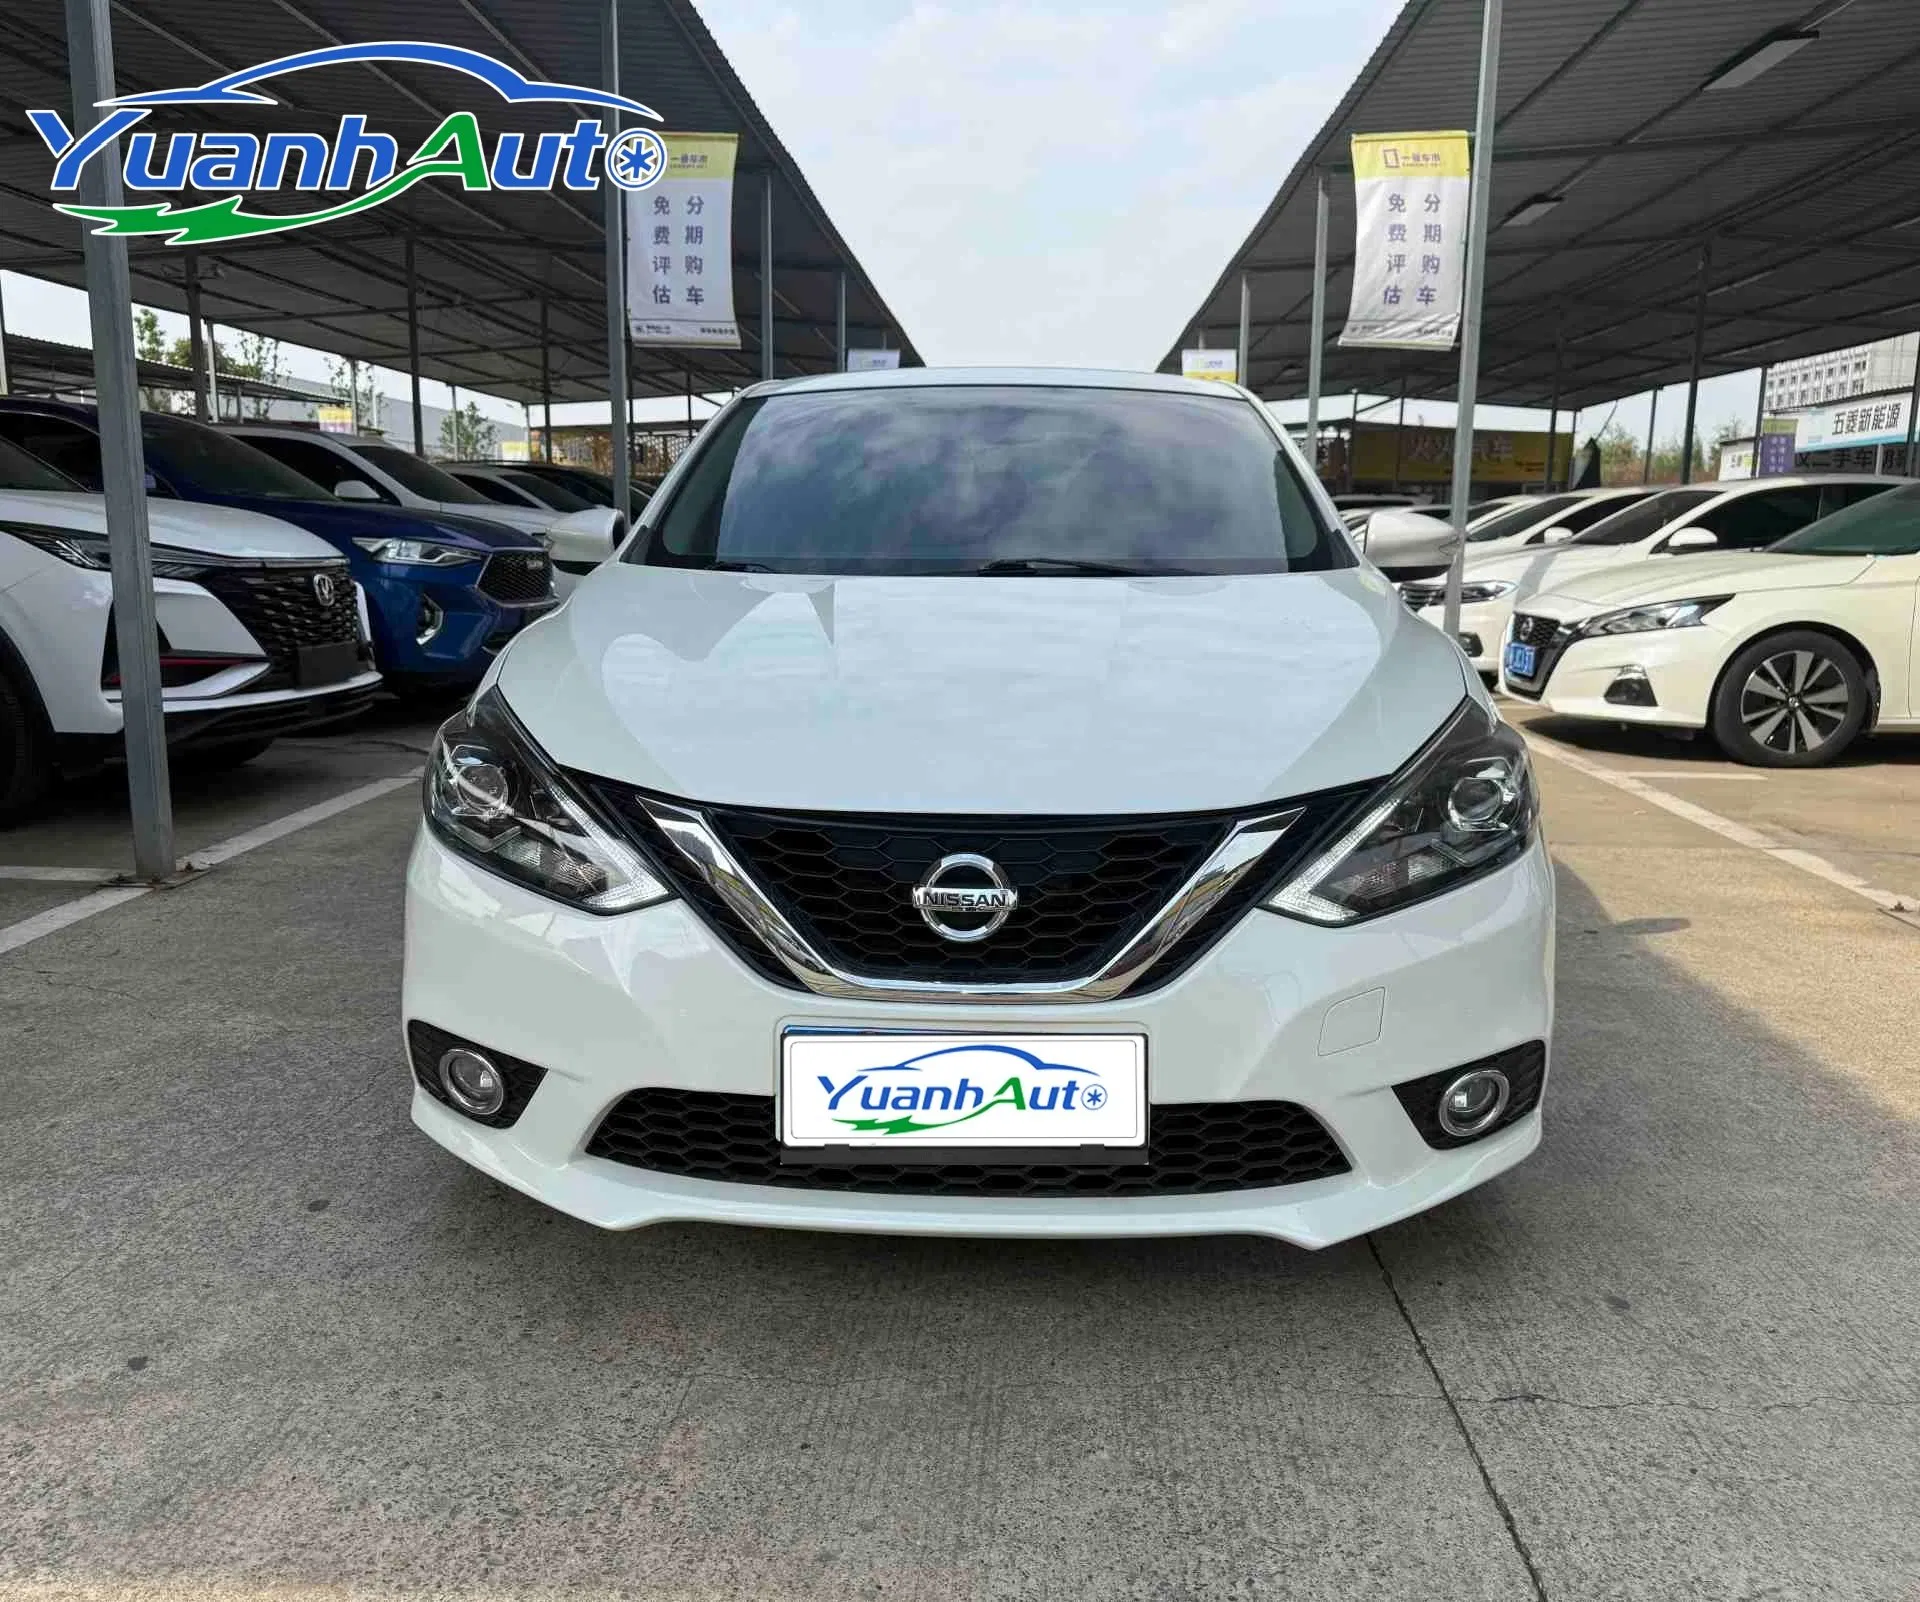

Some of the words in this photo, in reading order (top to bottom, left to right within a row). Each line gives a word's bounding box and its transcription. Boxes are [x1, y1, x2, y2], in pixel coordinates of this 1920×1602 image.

[653, 195, 671, 306] 免费评估
[684, 196, 704, 306] 分期购车
[1384, 193, 1407, 305] 免费评估
[1416, 193, 1441, 305] 分期购车
[1832, 402, 1902, 436] 五菱新能源
[922, 890, 1008, 908] NISSAN
